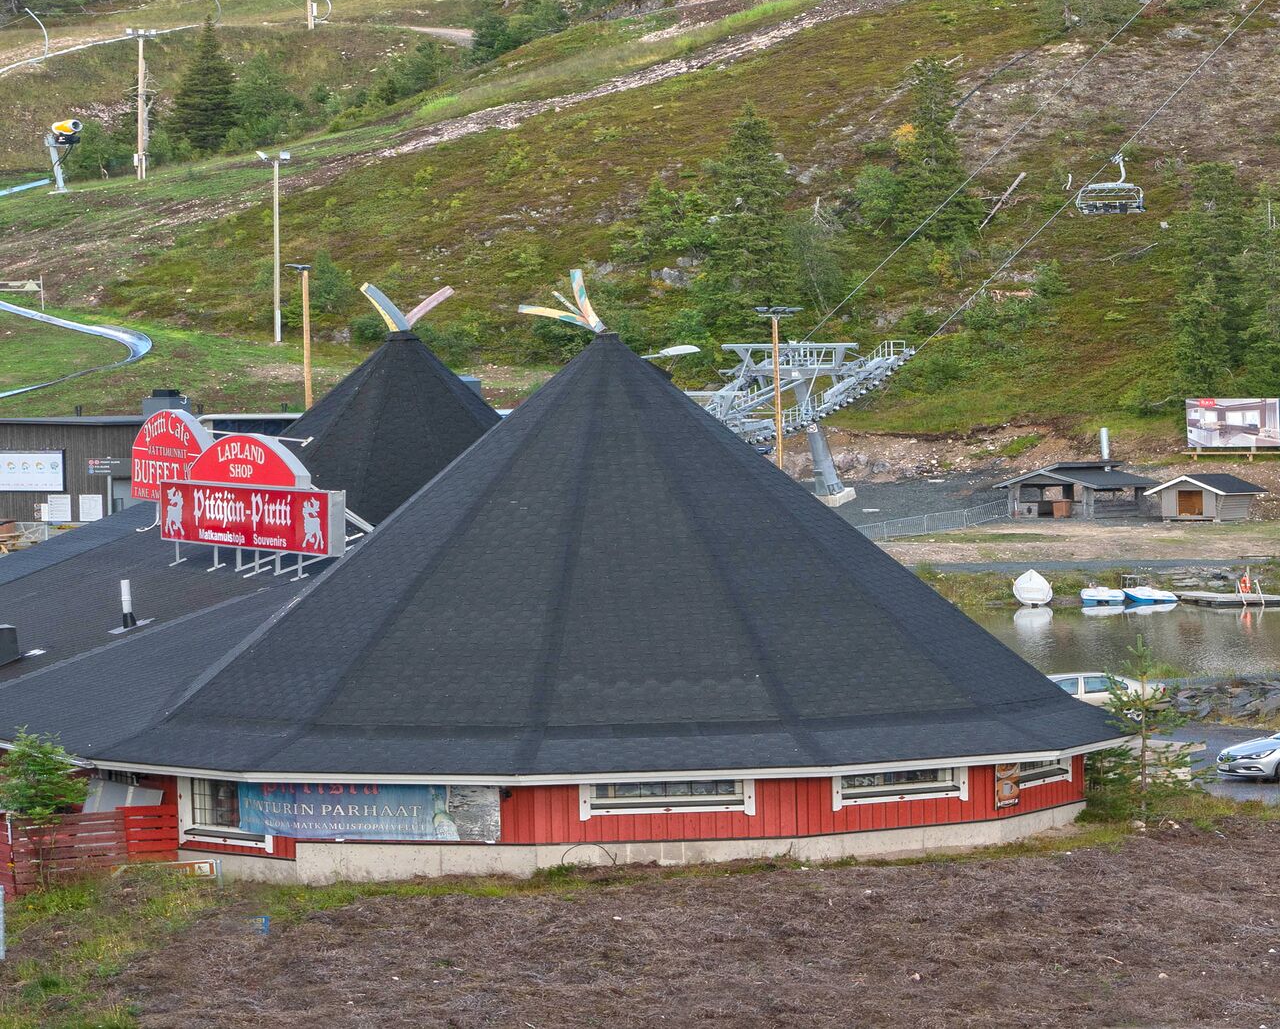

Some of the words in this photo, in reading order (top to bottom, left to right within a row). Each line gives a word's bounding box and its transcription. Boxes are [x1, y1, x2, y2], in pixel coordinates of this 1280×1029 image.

[168, 414, 190, 446] Cafe
[218, 442, 265, 464] LAPLAND
[134, 458, 180, 483] BUFFET
[229, 464, 253, 478] SHOP
[134, 488, 150, 499] TAKE
[199, 528, 245, 545] Matkamuistoja
[253, 535, 287, 548] Souvenirs
[244, 798, 314, 816] TUNTURIN
[321, 804, 422, 817] PARHAAT
